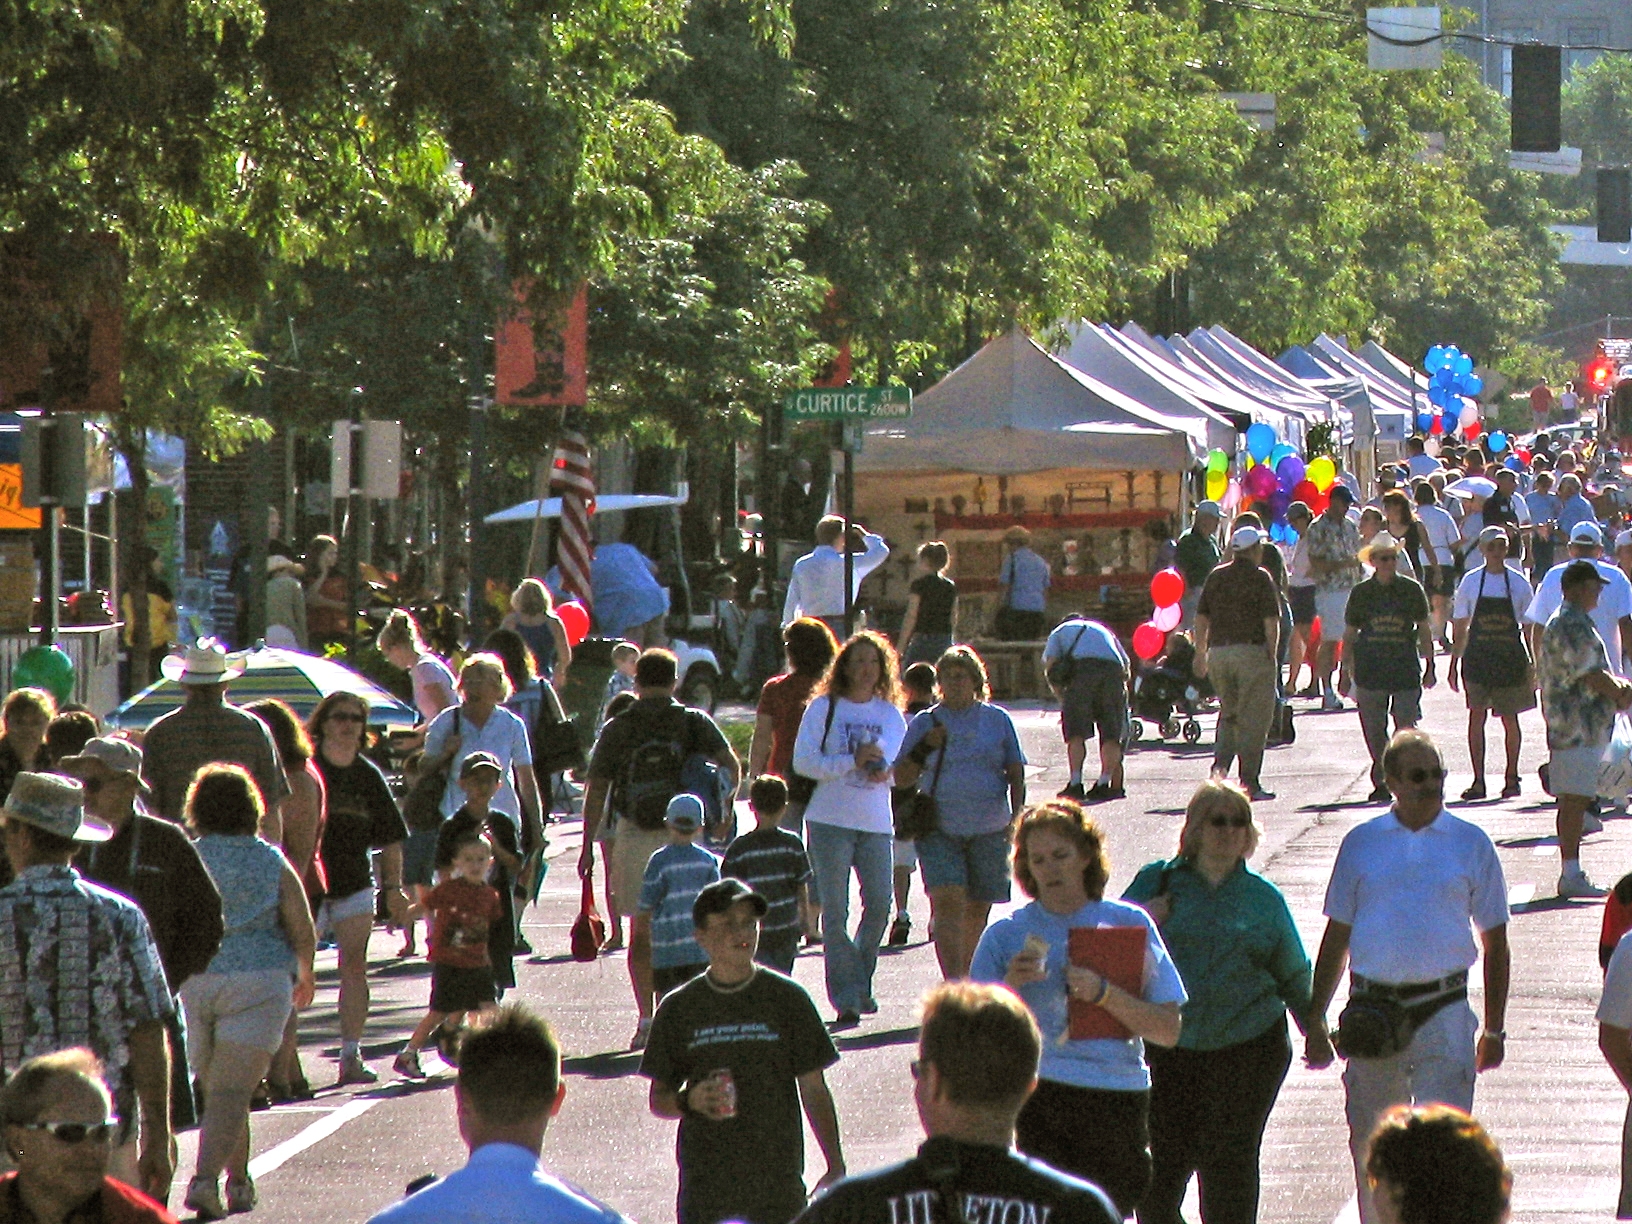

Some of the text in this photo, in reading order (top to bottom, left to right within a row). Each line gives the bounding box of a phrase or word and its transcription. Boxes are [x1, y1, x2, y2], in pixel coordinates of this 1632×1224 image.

[796, 393, 868, 414] CURTICE
[881, 389, 894, 403] ST
[887, 1189, 1051, 1224] LITETON
